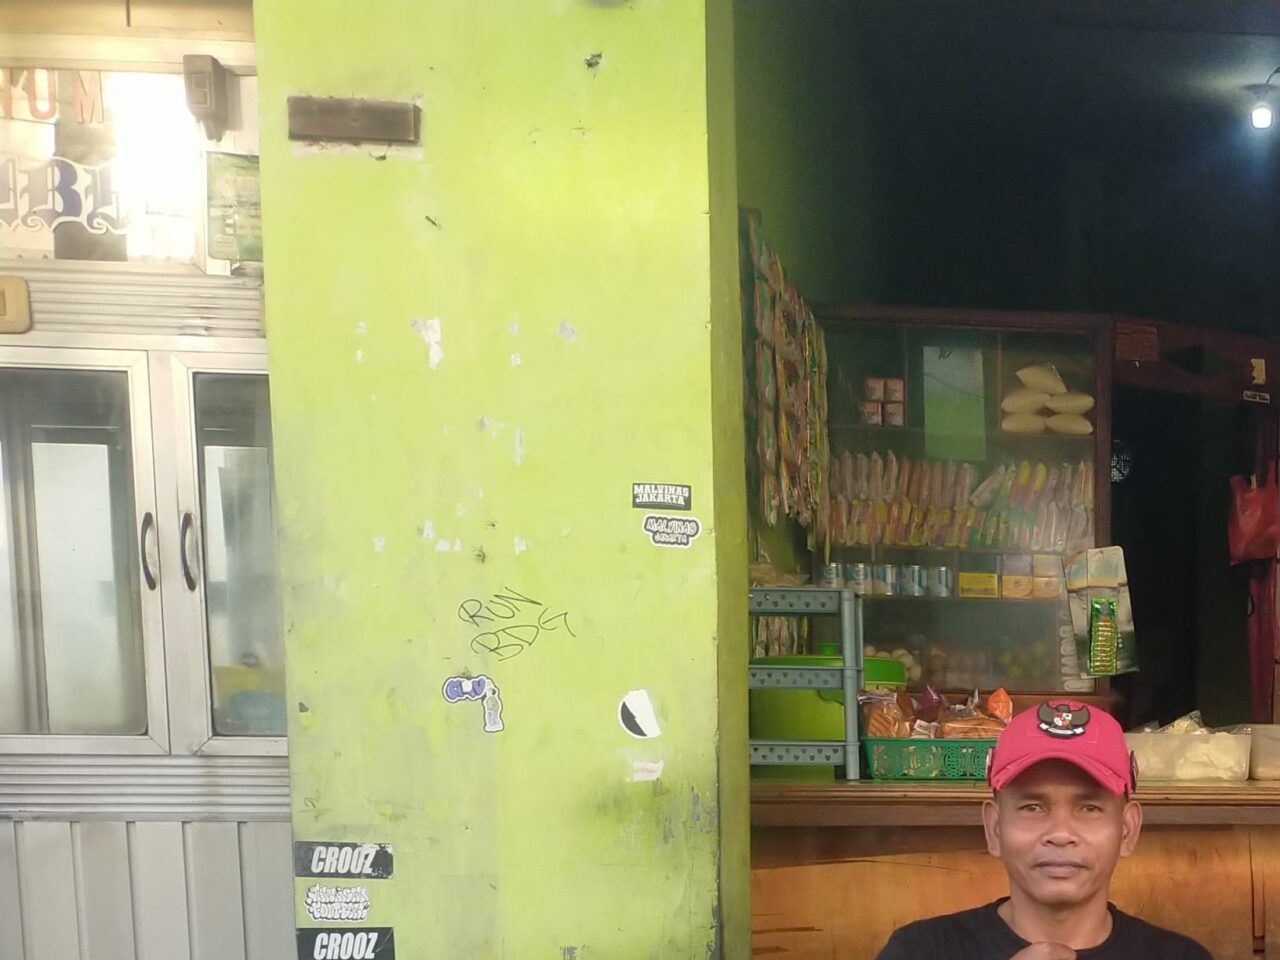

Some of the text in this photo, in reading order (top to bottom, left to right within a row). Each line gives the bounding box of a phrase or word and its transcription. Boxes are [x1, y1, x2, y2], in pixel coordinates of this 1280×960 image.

[633, 484, 690, 498] MALVINAS
[635, 493, 686, 506] JAKARTA
[311, 845, 378, 874] CROOZ
[313, 931, 379, 960] CROOZ
